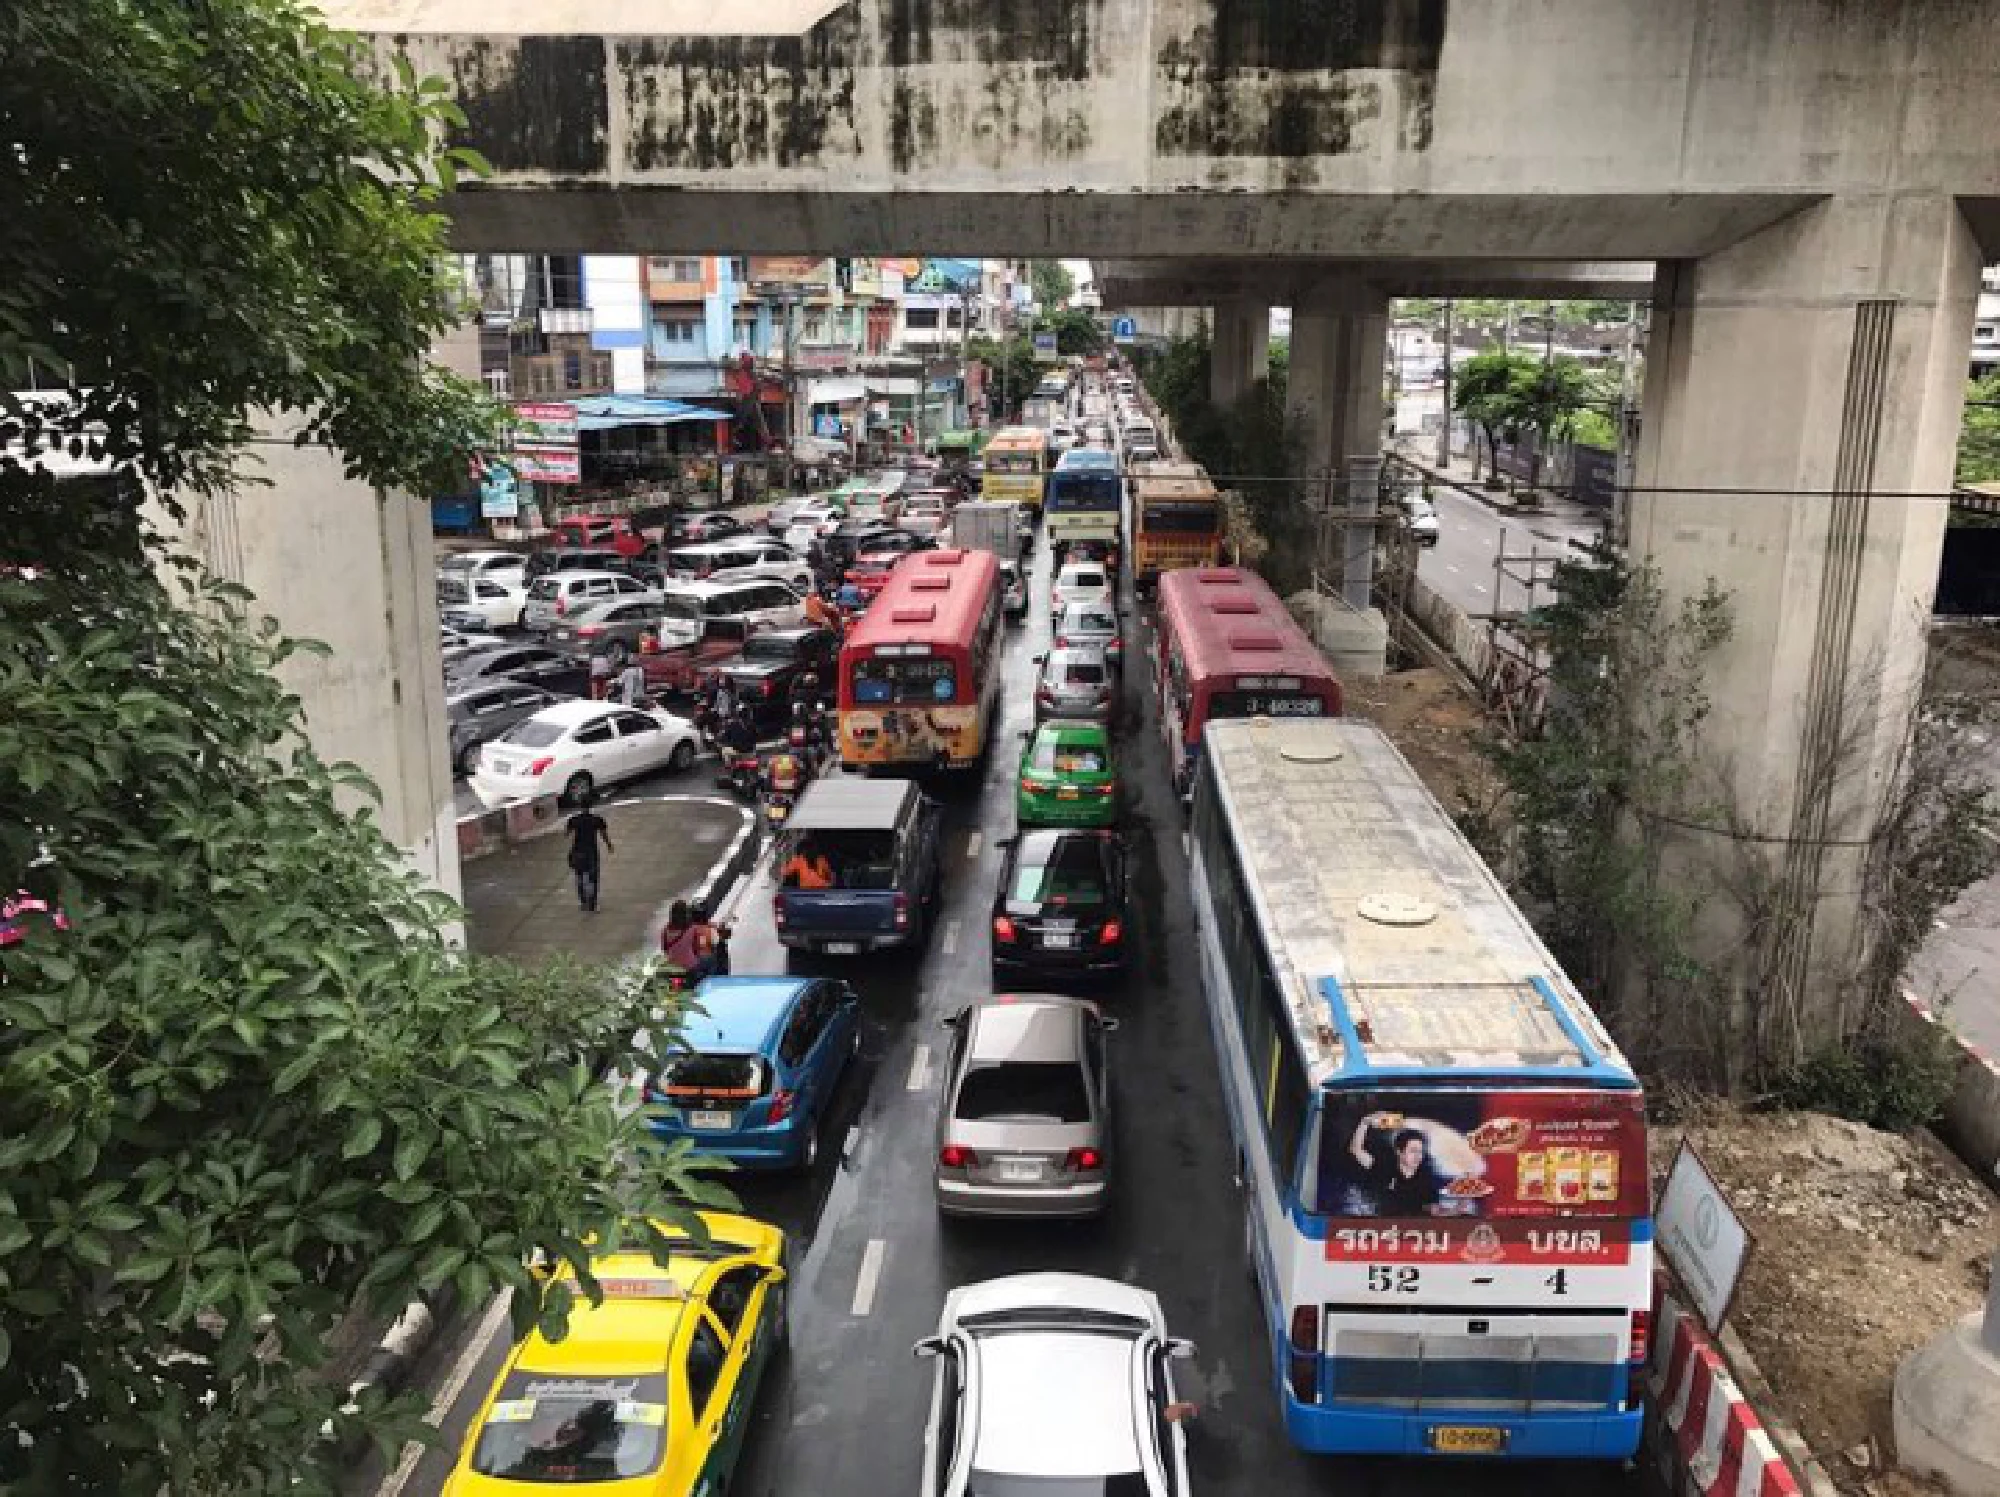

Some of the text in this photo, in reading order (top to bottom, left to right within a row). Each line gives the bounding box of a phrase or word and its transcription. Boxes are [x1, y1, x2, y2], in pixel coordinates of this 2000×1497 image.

[1335, 1225, 1608, 1255] รถร่วม บขส.
[1368, 1265, 1420, 1294] 52
[1544, 1268, 1568, 1294] 4
